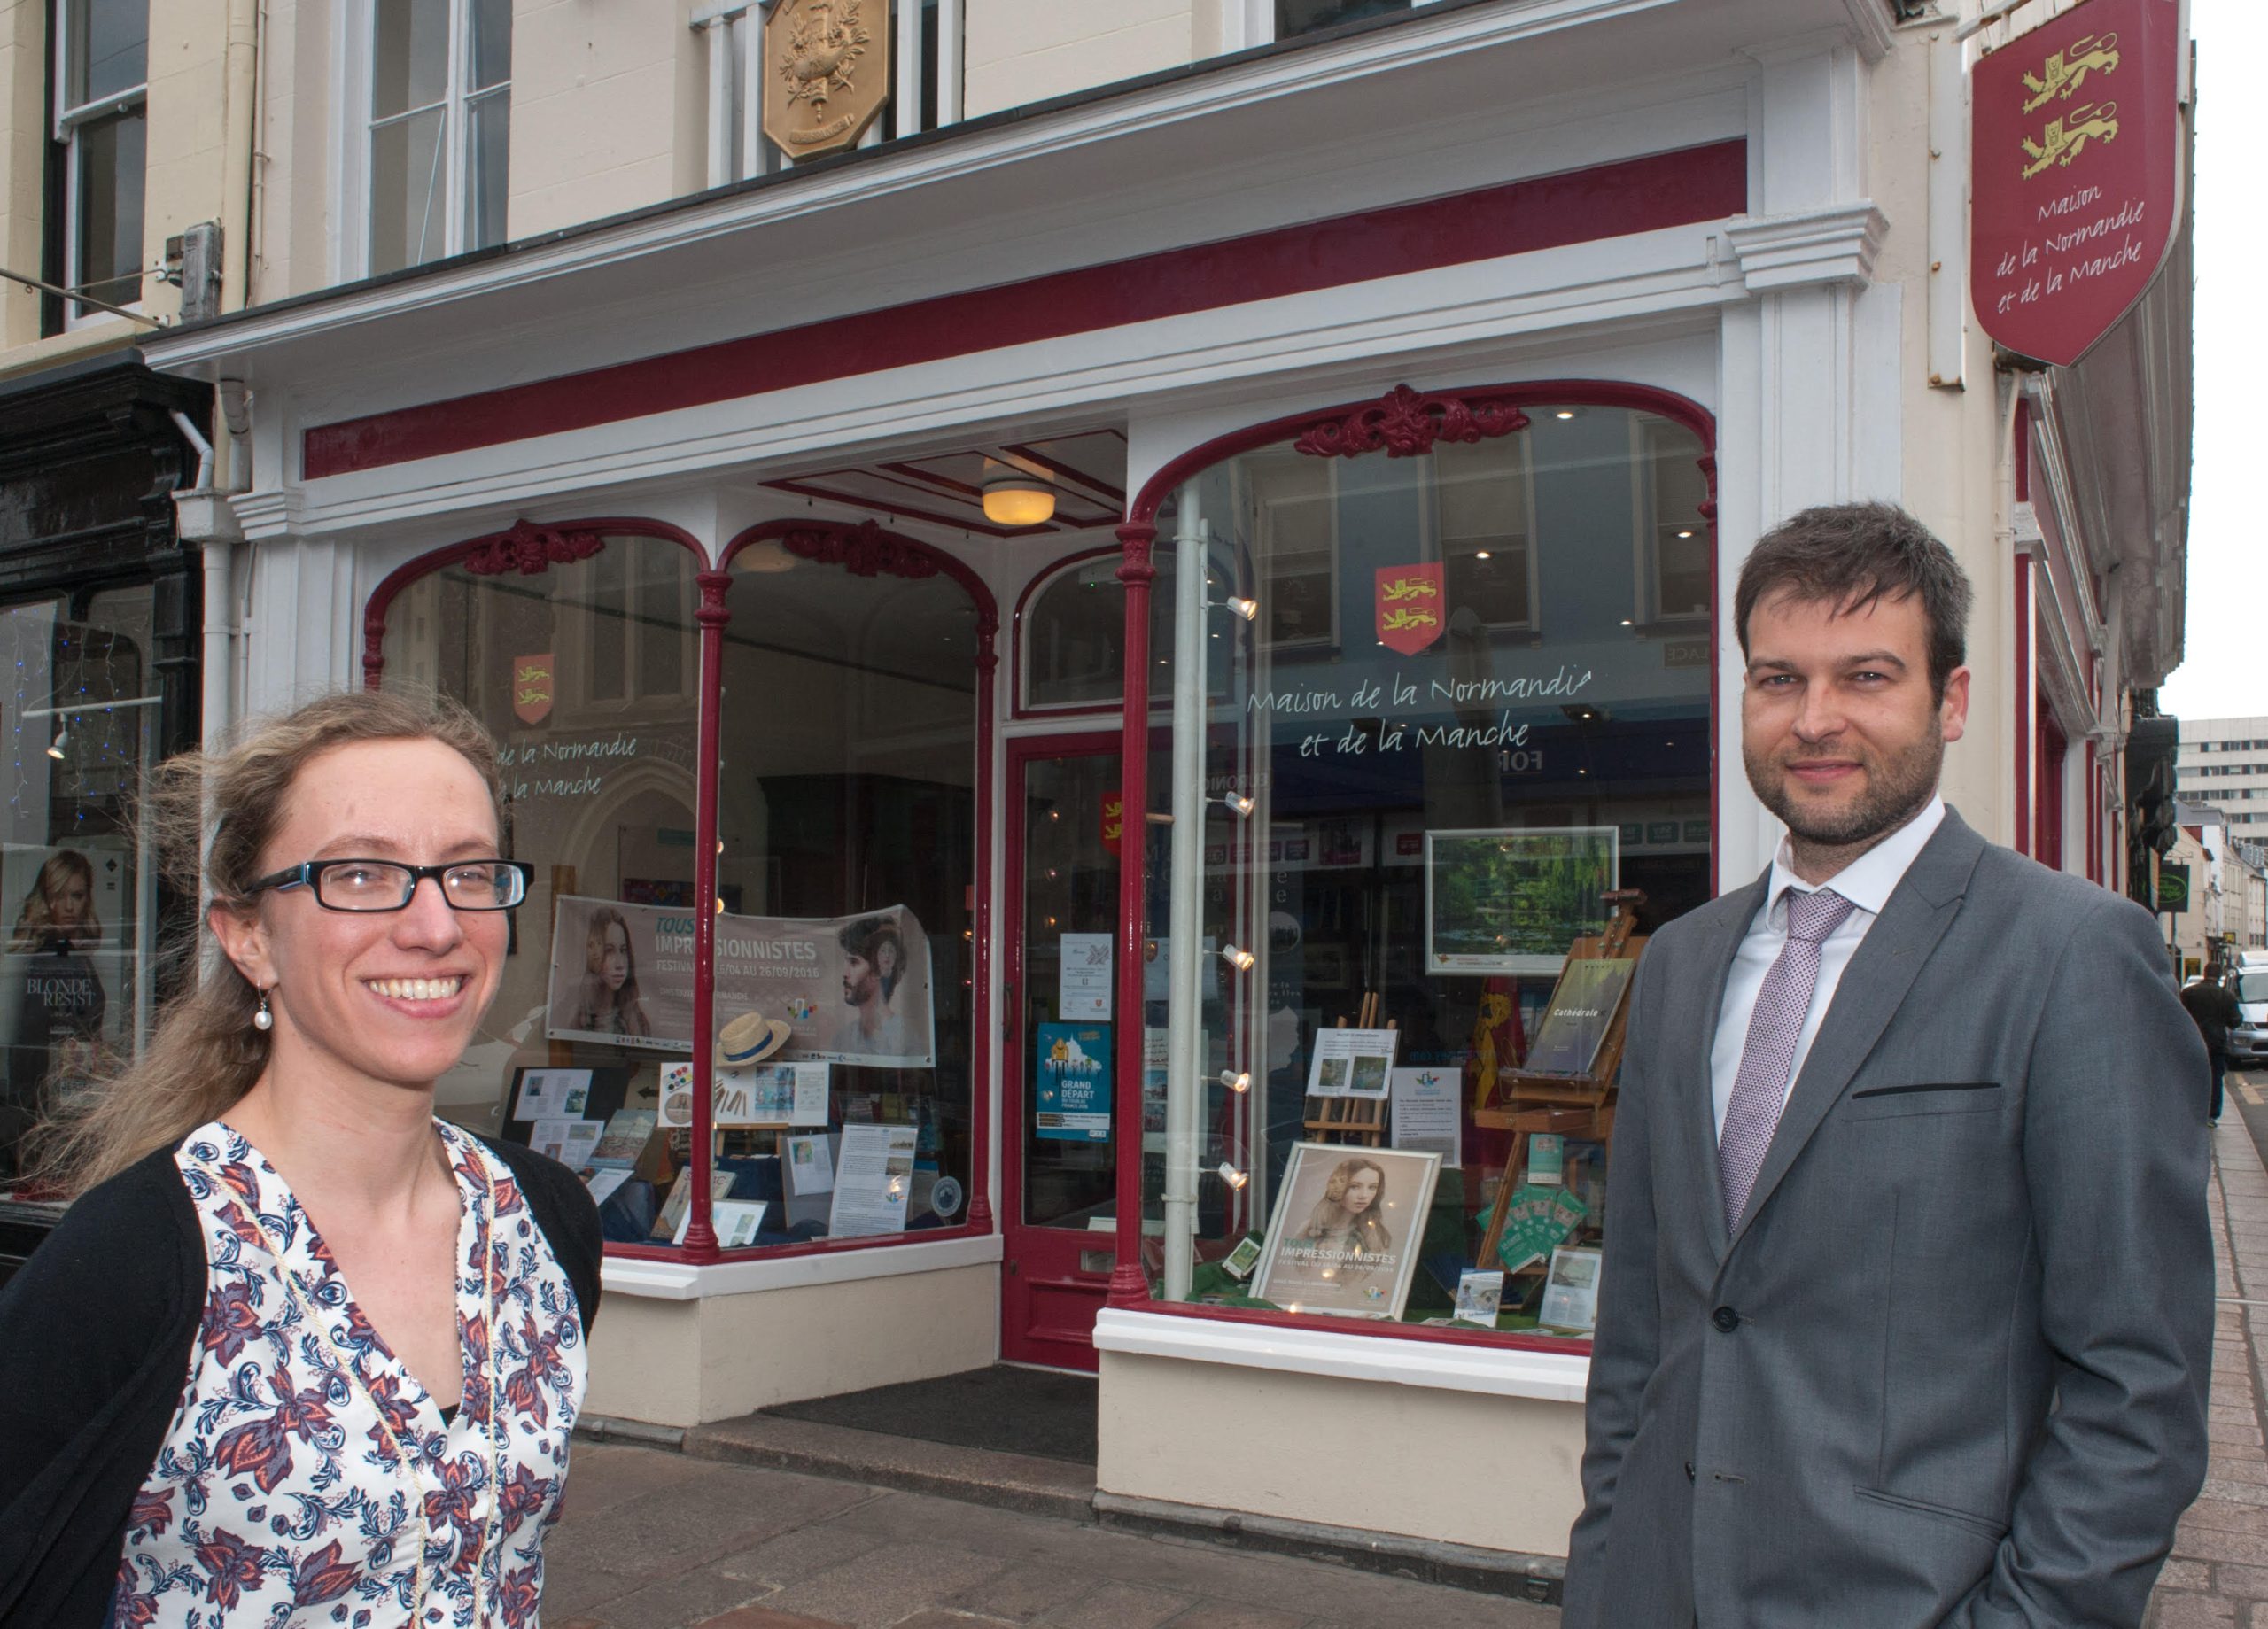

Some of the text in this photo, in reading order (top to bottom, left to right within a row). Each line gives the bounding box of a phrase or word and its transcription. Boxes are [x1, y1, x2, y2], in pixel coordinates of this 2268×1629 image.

[2038, 185, 2102, 222] Maison
[1997, 197, 2145, 277] de la Normandie
[1997, 234, 2142, 314] et de la Manche
[1247, 664, 1592, 713] Maison de la Normandie
[1300, 710, 1529, 757] et de la Manche
[497, 731, 637, 766] de la Normandie
[513, 773, 528, 798] la
[535, 765, 602, 795] Manche
[656, 917, 695, 934] TOUS
[656, 935, 817, 960] IMPRSIONNISTES
[656, 959, 695, 974] FESTIVA
[743, 966, 757, 976] AU
[760, 966, 820, 979] 26/09/2016
[27, 978, 92, 994] BLONDE
[44, 992, 96, 1007] RESIST
[1061, 1080, 1091, 1090] GRAND
[1061, 1088, 1095, 1098] DÉPART
[1281, 1247, 1397, 1265] IMPRESSIONNISTES
